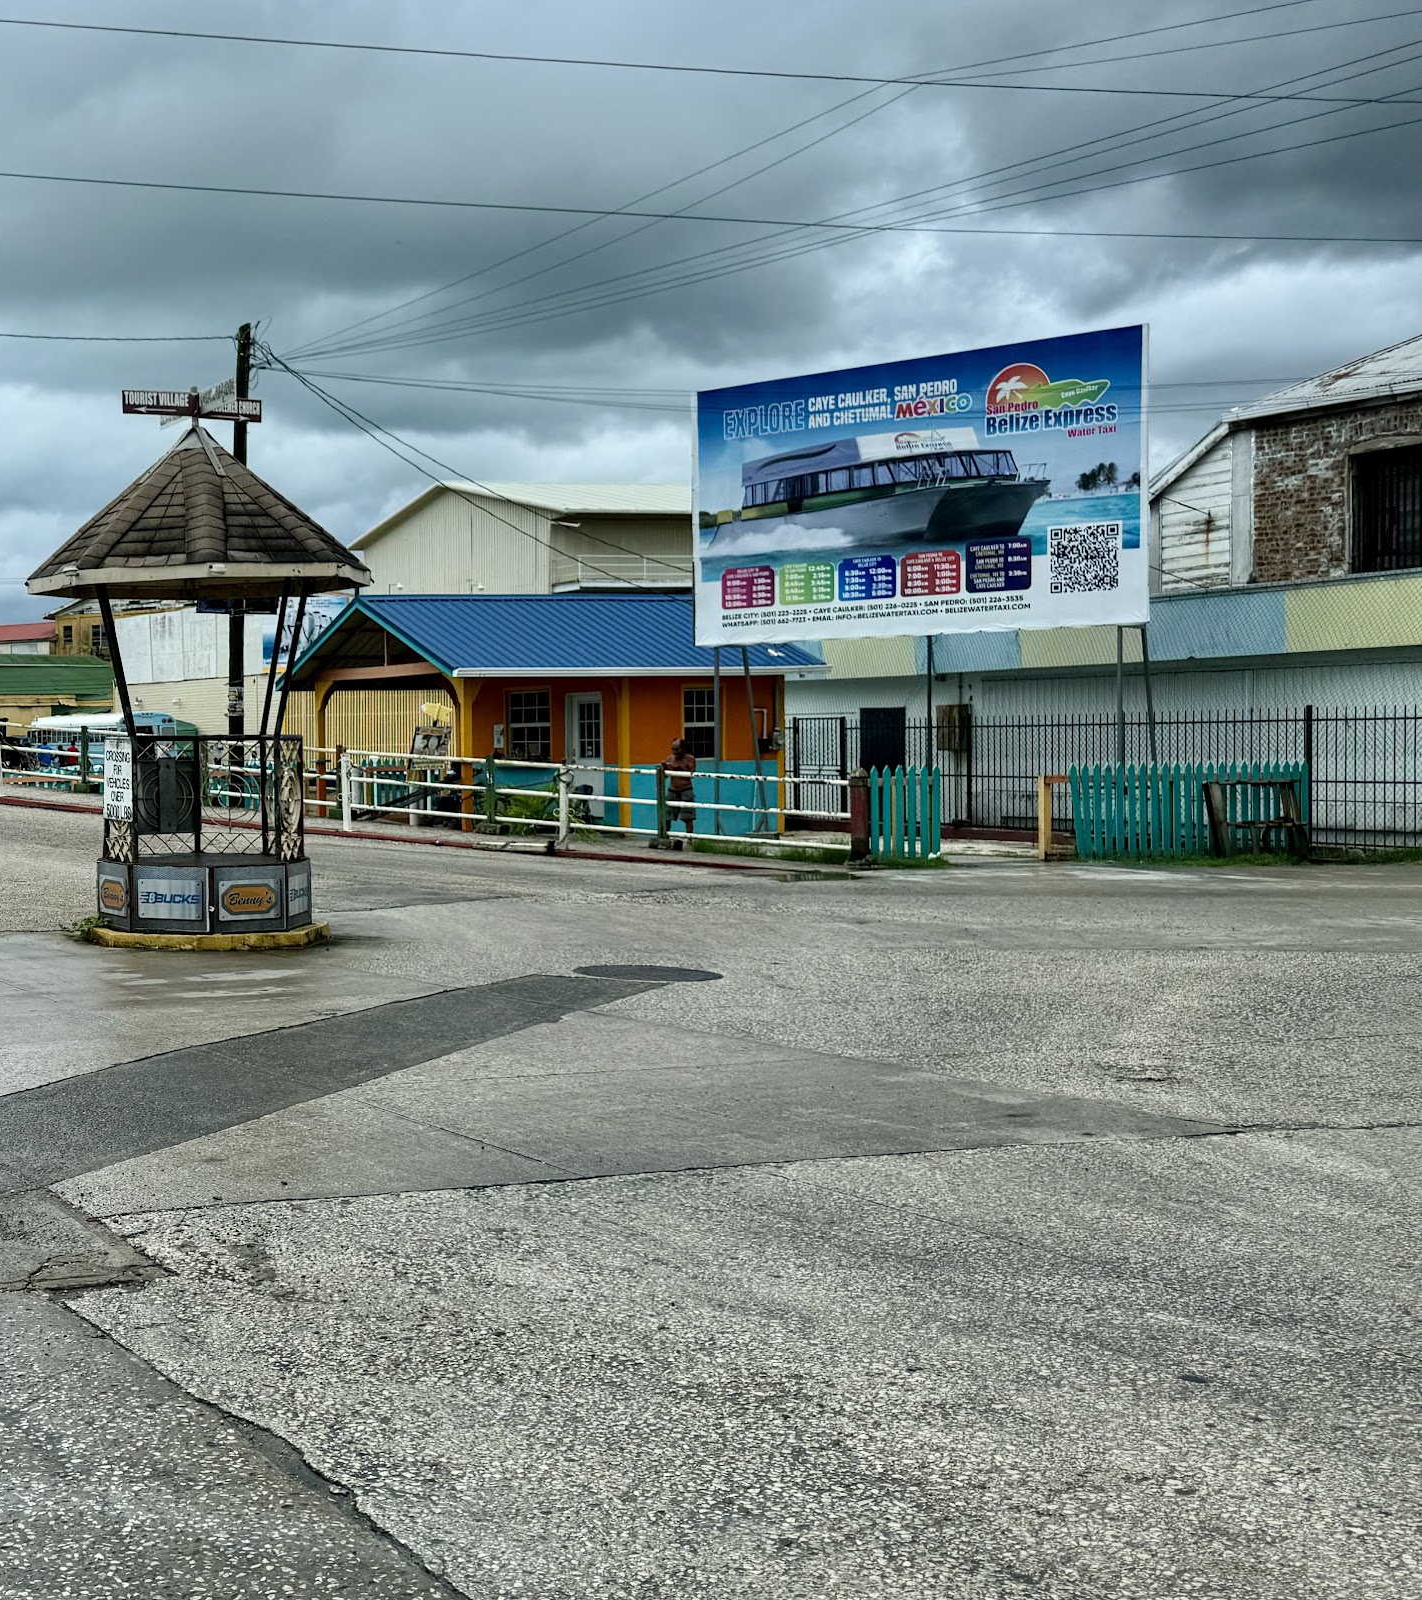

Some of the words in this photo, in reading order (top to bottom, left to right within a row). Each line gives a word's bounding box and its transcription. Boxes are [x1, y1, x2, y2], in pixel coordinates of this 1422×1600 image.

[124, 392, 157, 406] TOURIST
[159, 393, 189, 407] VILLAGE
[239, 402, 260, 415] CHURCH
[723, 400, 805, 440] EXPLORE
[808, 395, 836, 412] CAYE
[838, 388, 891, 409] CAULKER,
[894, 383, 917, 401] SAN
[919, 379, 958, 397] PEDRO
[987, 404, 1006, 415] San
[1008, 401, 1039, 412] Pedro
[808, 413, 830, 429] AND
[833, 407, 894, 426] CHETUMAL
[986, 413, 1040, 436] Belize
[1044, 405, 1117, 430] Express
[1068, 427, 1095, 438] Water
[1098, 425, 1116, 435] Taxi
[743, 612, 759, 620] CITY:
[760, 611, 776, 619] (501)
[813, 607, 831, 615] CAYE
[833, 605, 866, 613] CAULKER:
[867, 604, 883, 612] (501)
[885, 602, 918, 610] 226-0225
[924, 600, 939, 608] SAN
[941, 598, 968, 606] PEDRO:
[970, 596, 987, 605] (501)
[989, 595, 1024, 603] 226-3535
[722, 620, 760, 628] WHATSAPP:
[945, 603, 1031, 614] BELIZEWATERTAXI.COM
[106, 750, 130, 763] CROSSING
[111, 791, 124, 803] OVER
[103, 887, 124, 903] Benny's
[228, 892, 272, 907] Benny's
